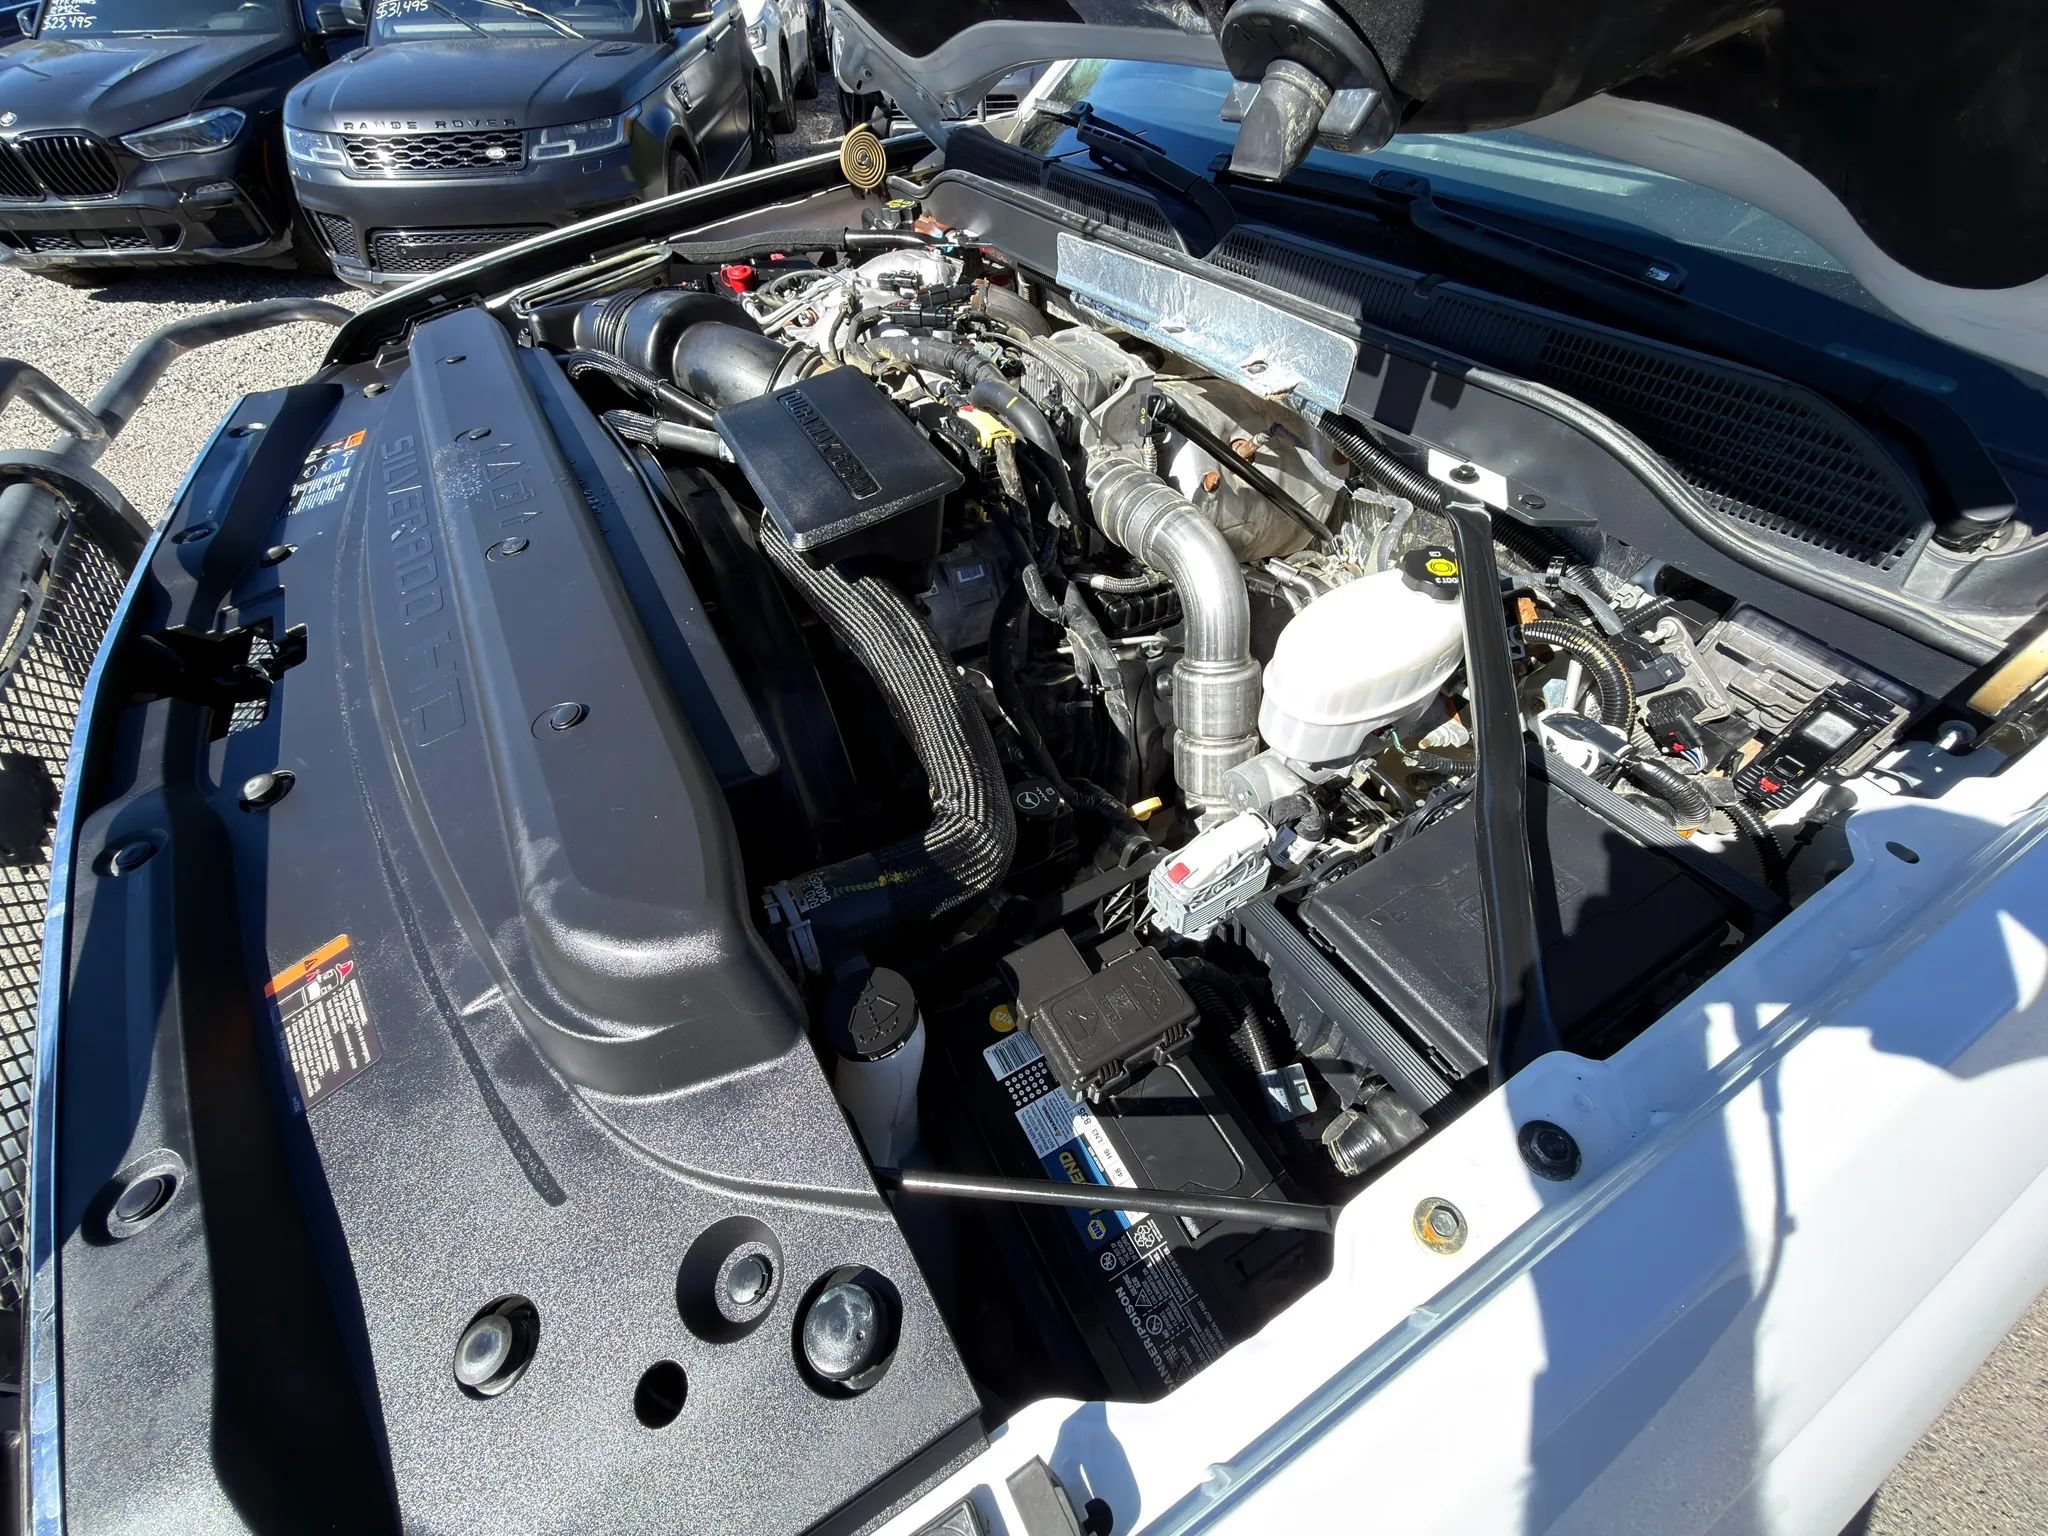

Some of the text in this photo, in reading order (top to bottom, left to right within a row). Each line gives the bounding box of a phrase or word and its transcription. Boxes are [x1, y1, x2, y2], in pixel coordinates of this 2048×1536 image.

[376, 0, 429, 19] $31,495
[42, 16, 97, 30] $25,495
[343, 118, 516, 130] RANGE ROVER
[381, 434, 466, 747] SILVERADO HD
[1076, 1106, 1092, 1125] 835
[1090, 1128, 1103, 1143] LN3
